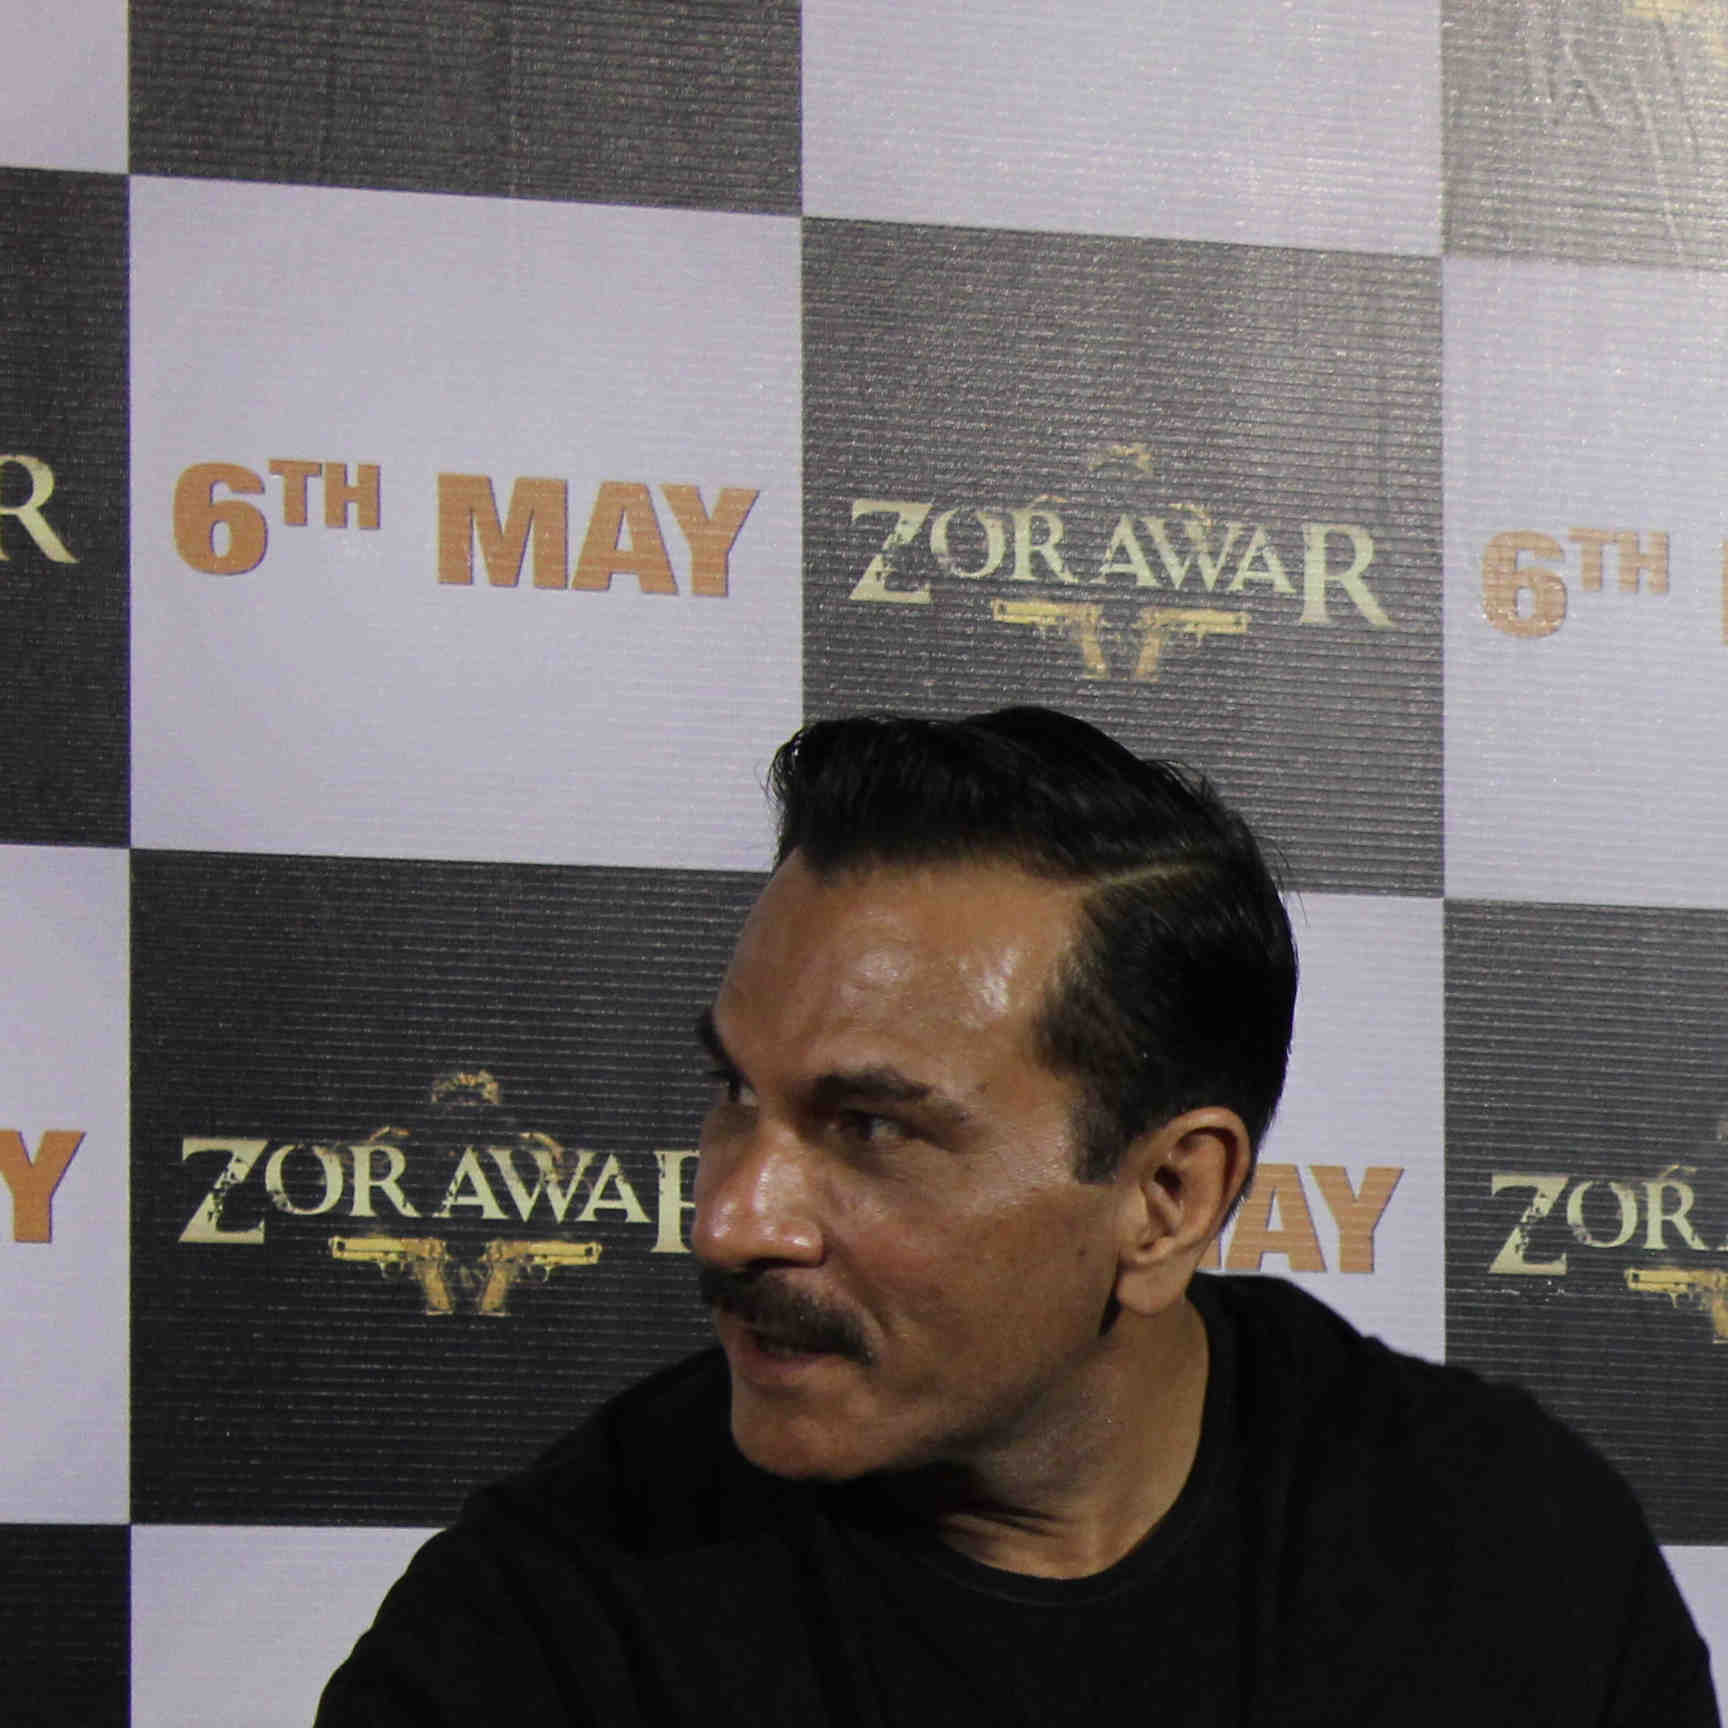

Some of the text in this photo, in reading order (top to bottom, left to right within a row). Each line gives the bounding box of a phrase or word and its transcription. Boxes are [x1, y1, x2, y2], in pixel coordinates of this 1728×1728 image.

[173, 459, 381, 575] 6TH
[437, 474, 759, 597] MAY
[850, 498, 1394, 627] ZORAWAR
[1480, 530, 1671, 638] 6TH
[1199, 1163, 1404, 1274] AY
